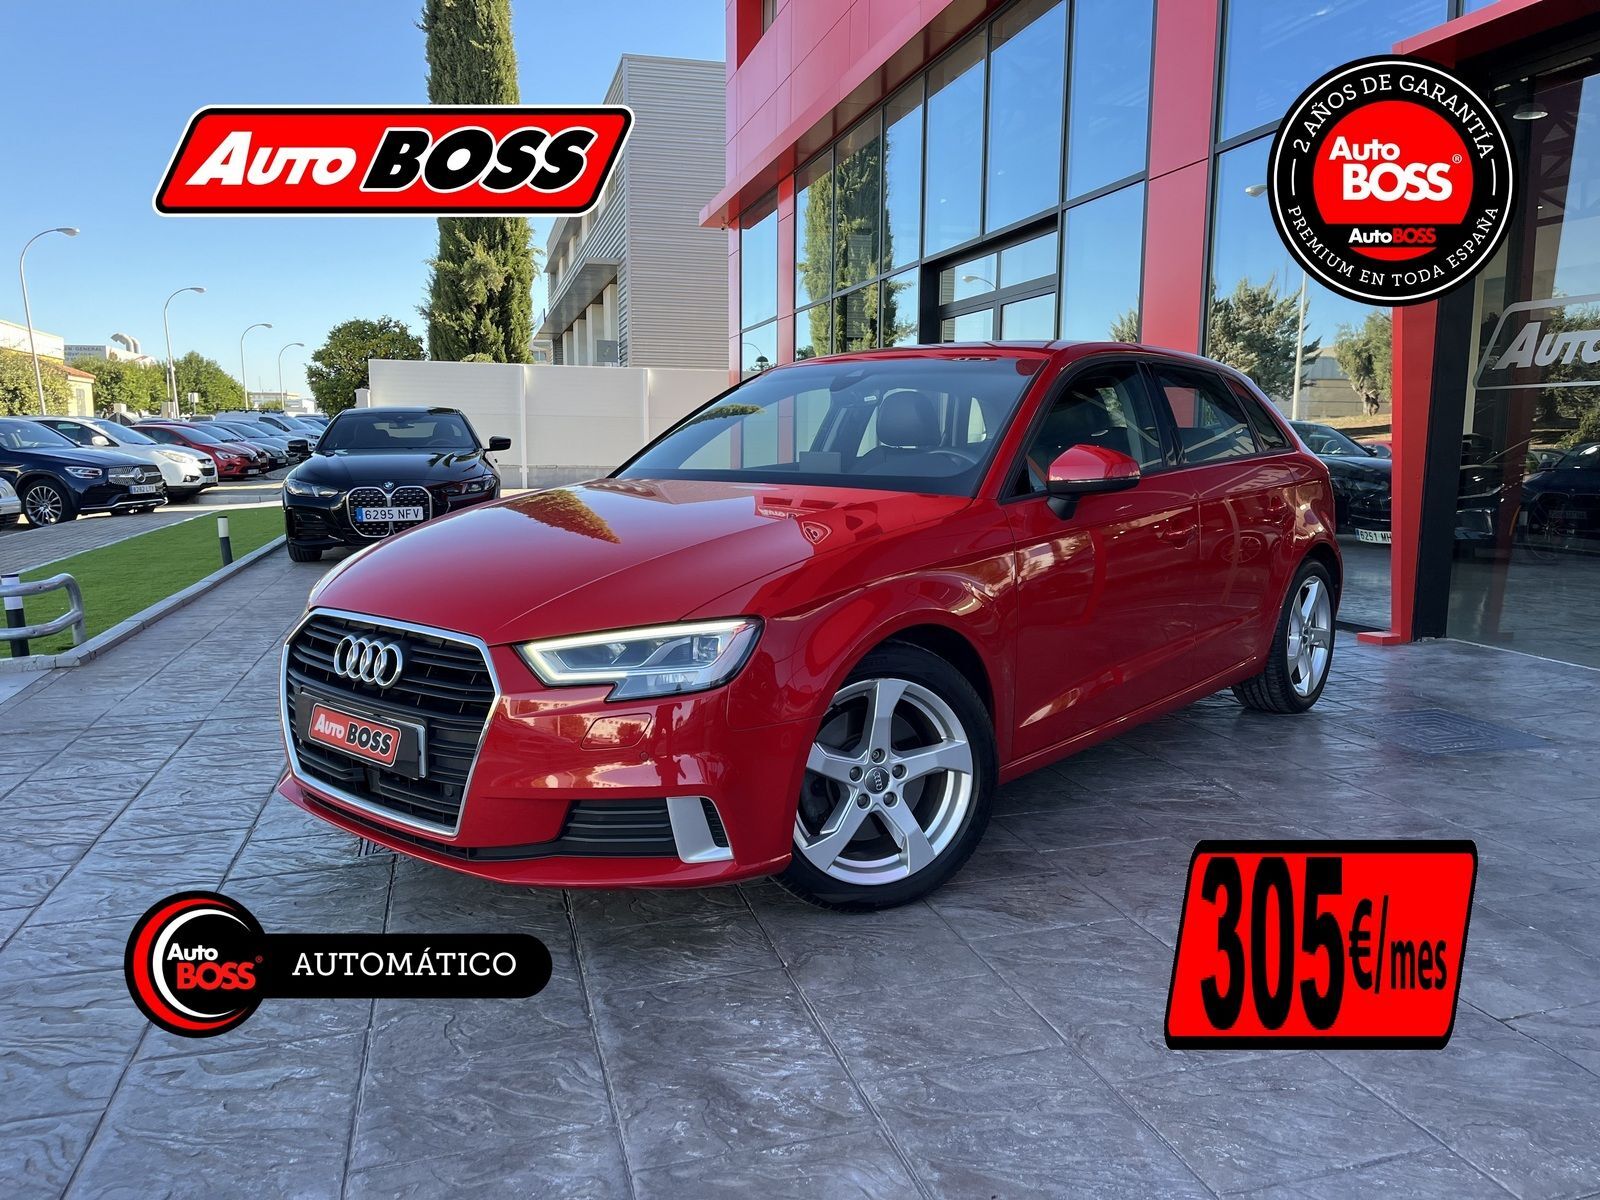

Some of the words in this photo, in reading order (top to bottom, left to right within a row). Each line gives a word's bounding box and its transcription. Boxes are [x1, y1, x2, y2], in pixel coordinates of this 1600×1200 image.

[364, 509, 394, 520] 6295
[397, 508, 420, 519] NFV
[1360, 530, 1378, 542] 6251
[345, 721, 394, 757] BOSS
